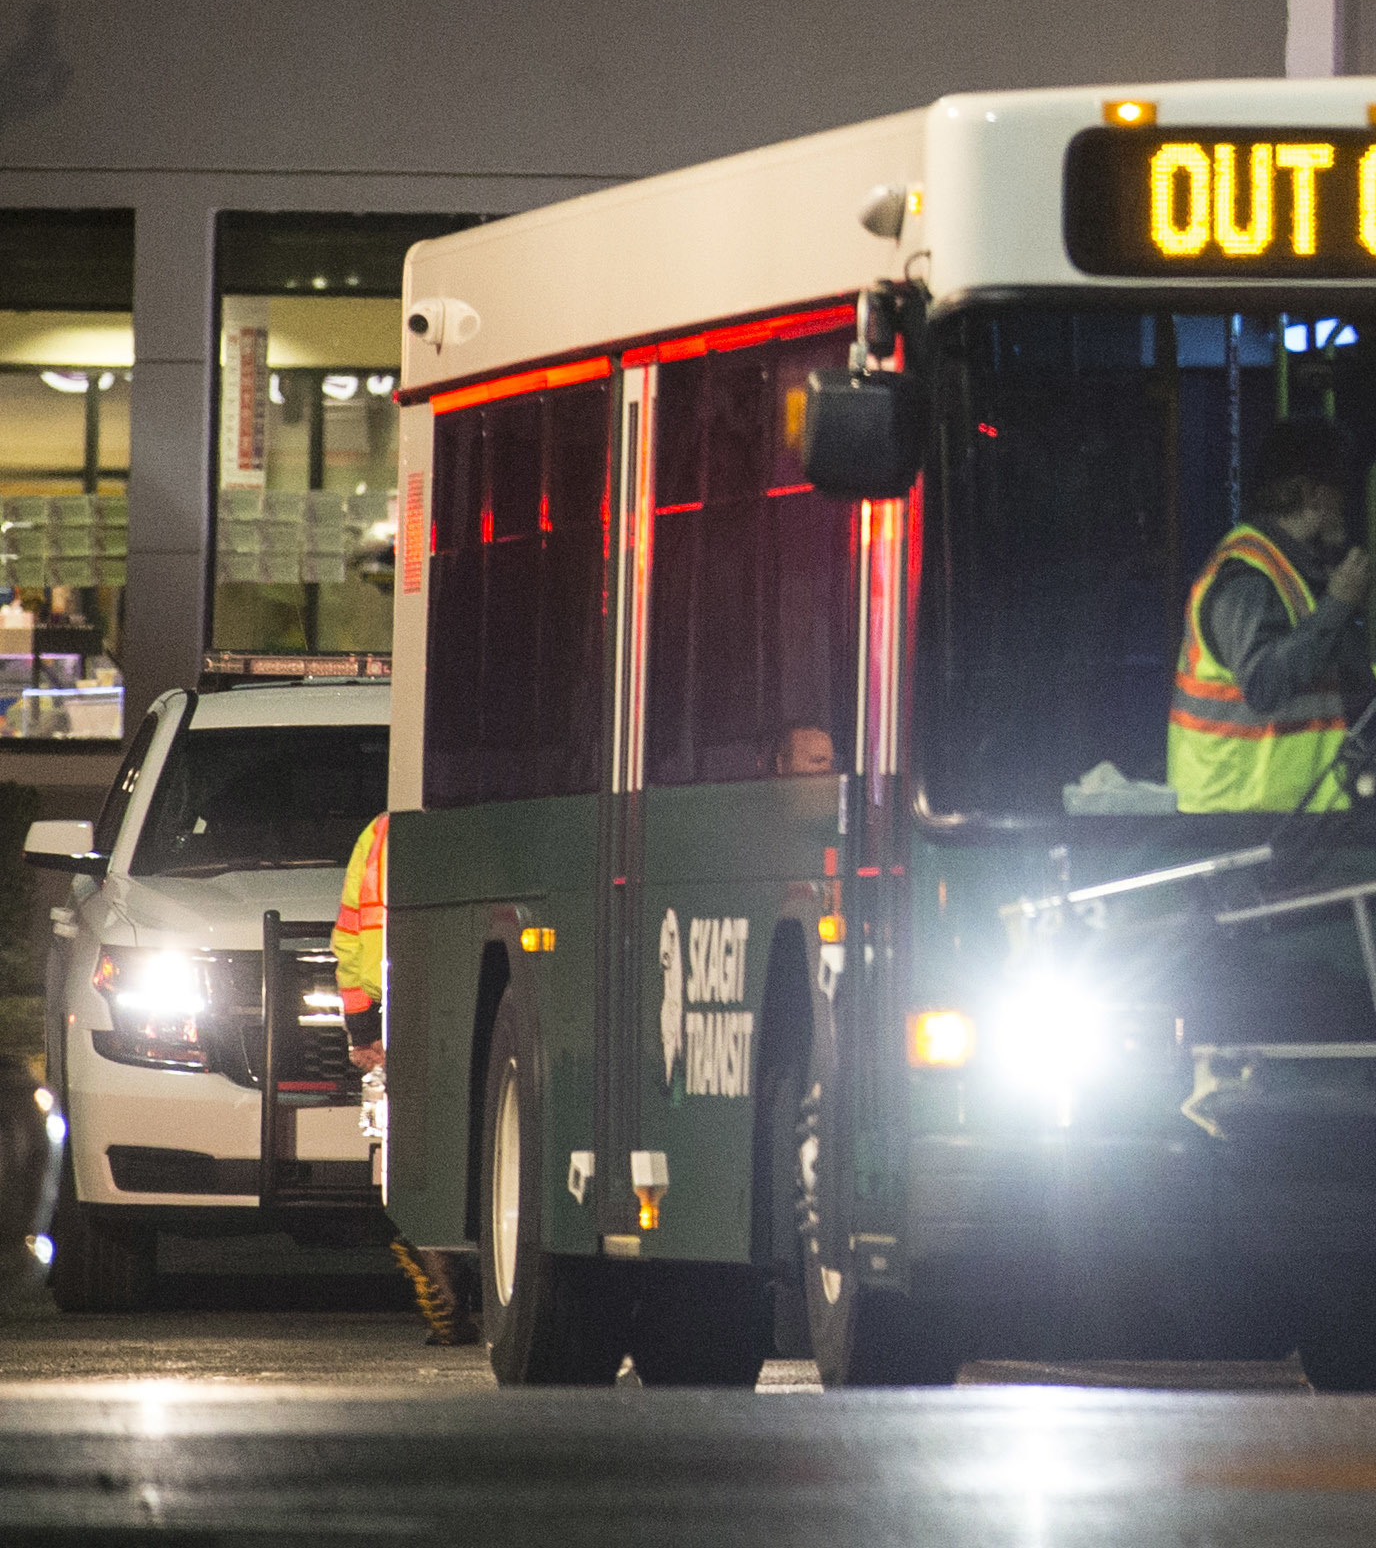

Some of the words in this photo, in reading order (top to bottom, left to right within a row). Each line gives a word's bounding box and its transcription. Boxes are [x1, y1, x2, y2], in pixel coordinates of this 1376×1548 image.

[1149, 142, 1335, 258] OUT
[687, 917, 749, 1003] SKAGIT
[686, 1011, 754, 1097] TRANSIT
